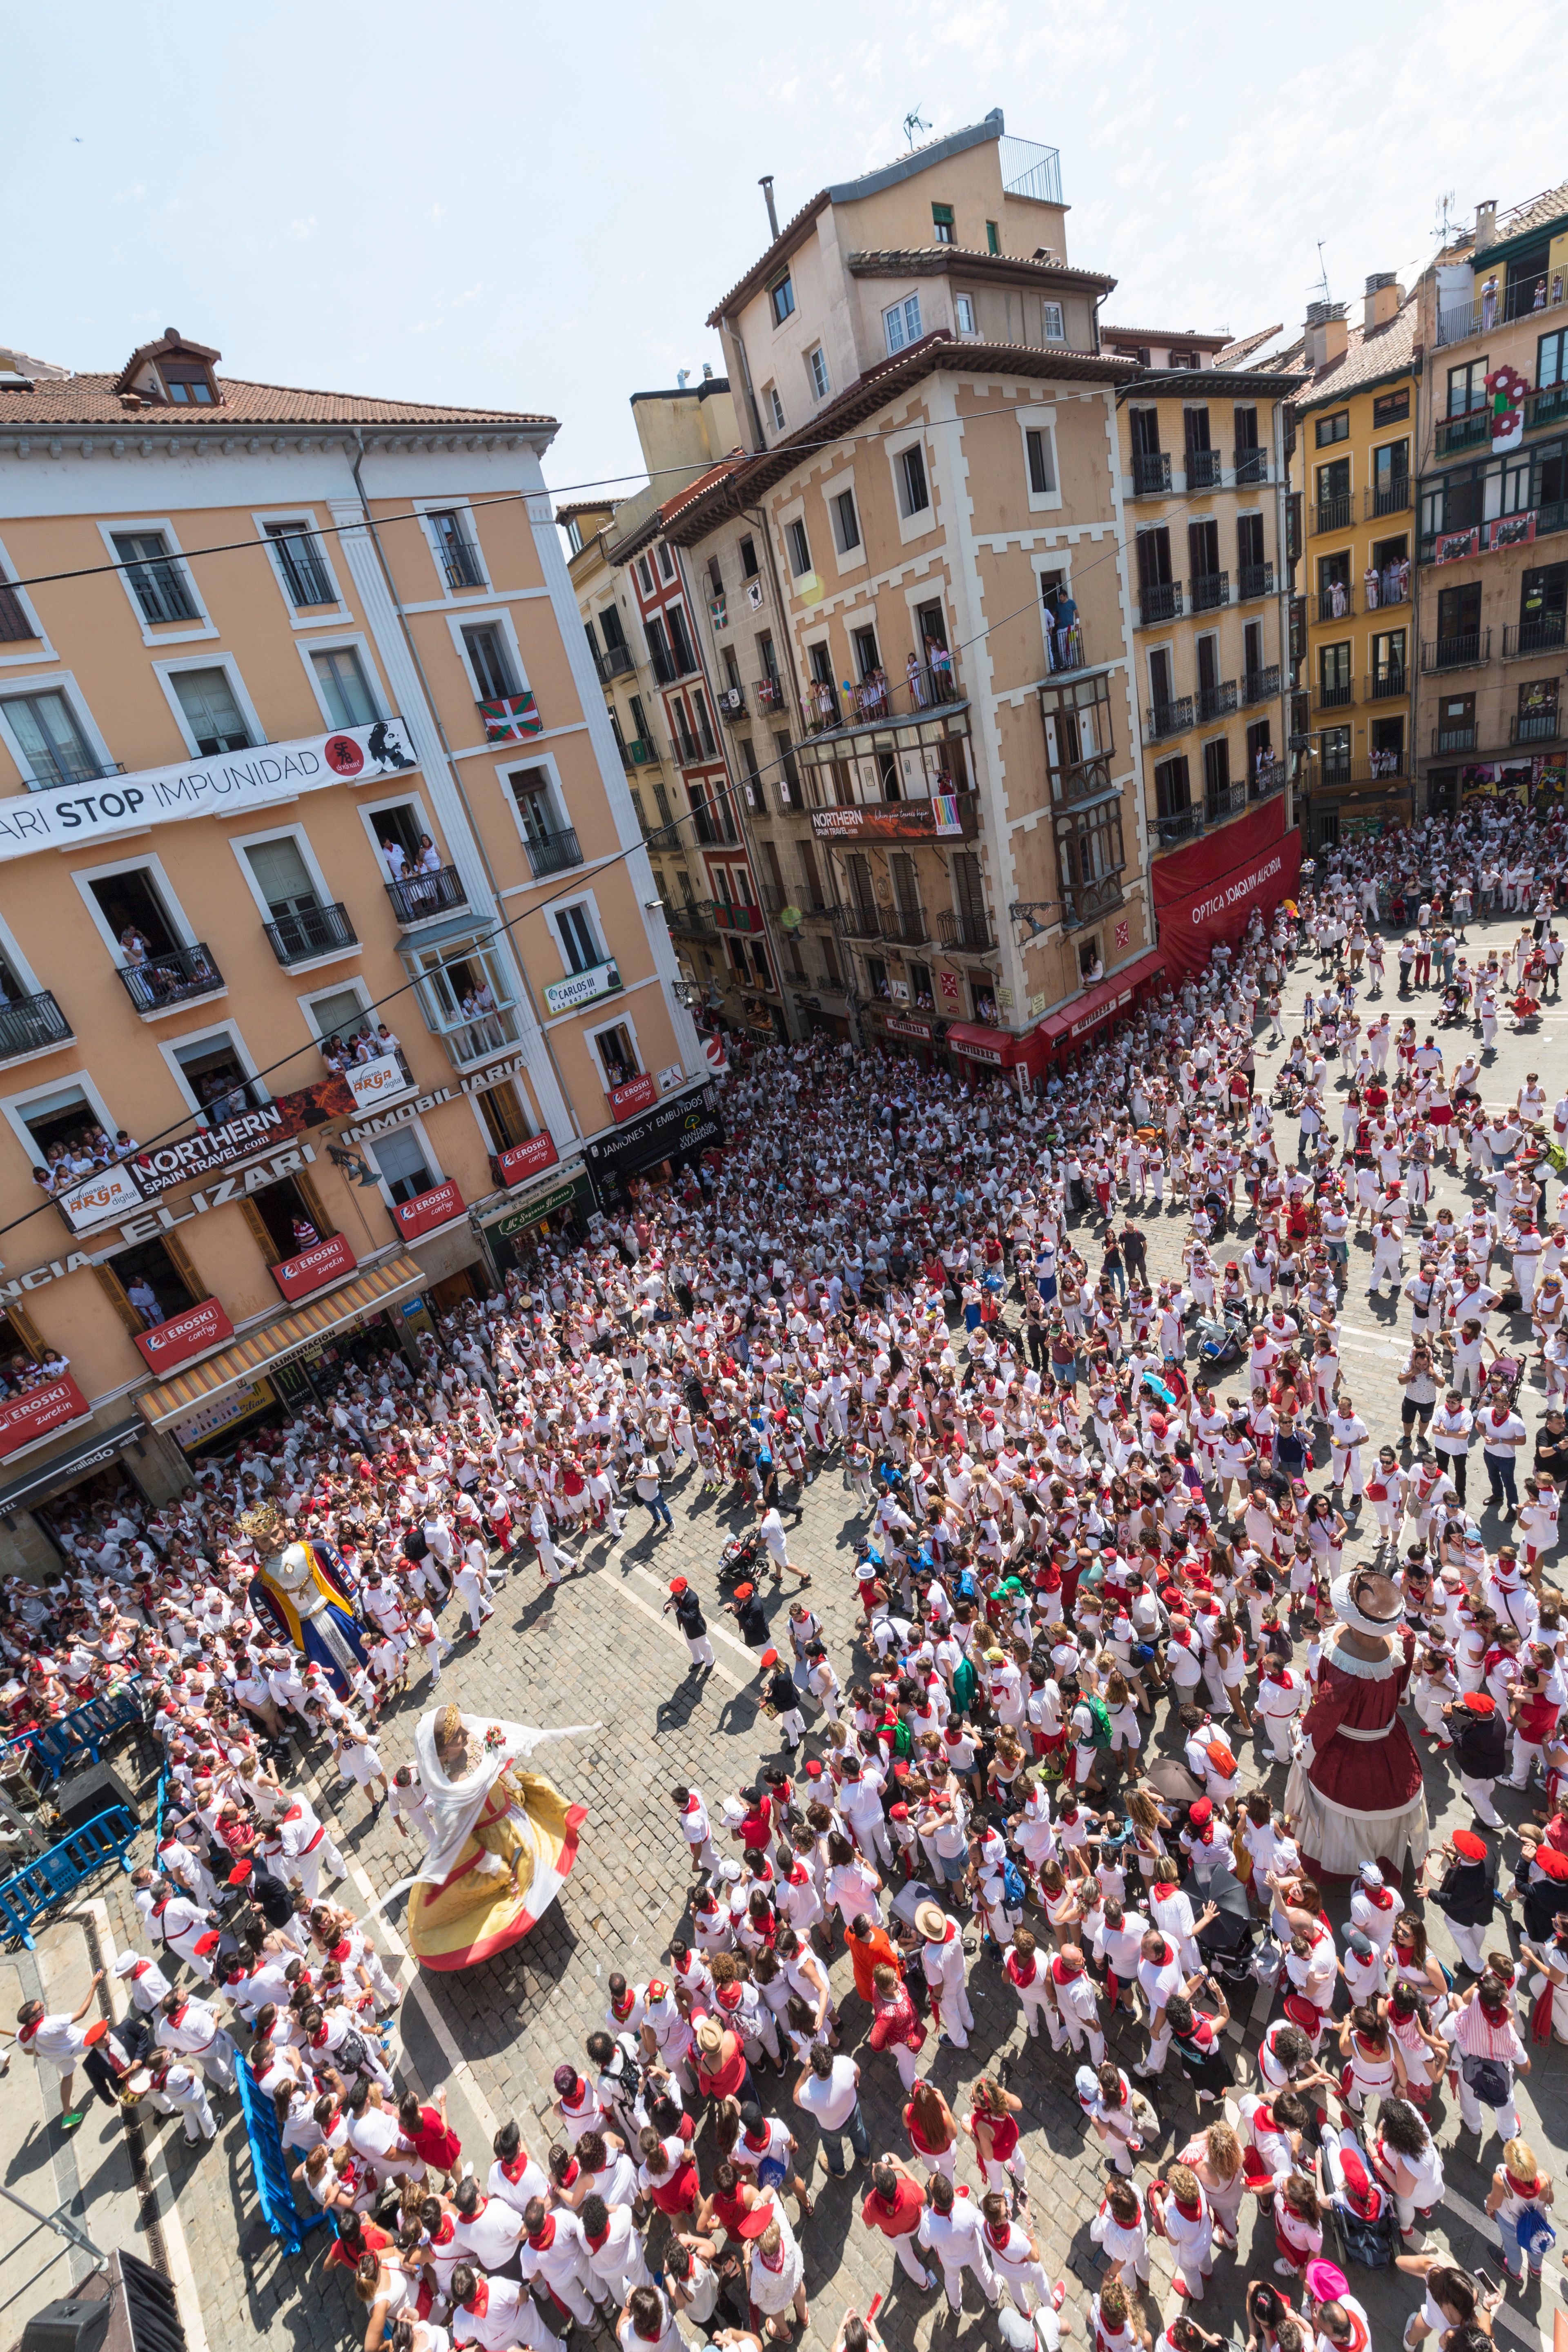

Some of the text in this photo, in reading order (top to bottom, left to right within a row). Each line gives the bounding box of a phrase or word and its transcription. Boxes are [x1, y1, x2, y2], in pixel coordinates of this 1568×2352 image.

[56, 788, 144, 827] STOP
[151, 751, 320, 807] IMPUNIDAD
[812, 810, 864, 828] NORTHERN
[1192, 895, 1224, 924] OPTICA
[1225, 873, 1256, 905] JOAQUIN
[556, 972, 592, 990] INMOBILIARIA
[558, 981, 586, 1000] CARLOS
[552, 989, 597, 1011] 649 847 747
[1077, 1002, 1111, 1030] GUTIERREZ
[892, 1020, 924, 1035] GUTIERREZ
[957, 1042, 995, 1060] GUTIERREZ
[352, 1070, 380, 1085] Luminosos
[354, 1069, 392, 1093] ARGA
[384, 1076, 402, 1089] digital
[624, 1080, 650, 1097] EROSKI
[635, 1089, 651, 1102] contigo
[646, 1122, 653, 1131] Y
[131, 1106, 282, 1183] NORTHERN
[680, 1125, 717, 1150] SALAMANCA
[120, 1143, 317, 1245] ELIZARI
[340, 1055, 529, 1146] INMOBILIARIA
[516, 1139, 546, 1159] EROSKI
[528, 1151, 548, 1163] contigo
[143, 1134, 270, 1194] SPAIN TRAVEL.com
[67, 1184, 105, 1204] Luminosos
[70, 1183, 122, 1214] ARGA
[112, 1189, 137, 1207] digital
[416, 1189, 451, 1212] EROSKI
[519, 1193, 539, 1206] Sagrario
[540, 1182, 559, 1195] Navarro
[431, 1200, 454, 1216] contigo
[519, 1205, 545, 1223] Sagrario
[546, 1190, 569, 1207] Navarro
[300, 1244, 339, 1269] EROSKI
[317, 1256, 344, 1275] zurekin
[444, 1261, 451, 1270] 2
[167, 1310, 214, 1339] EROSKI
[188, 1323, 217, 1342] contigo
[269, 1330, 336, 1372] ALIMENTACIÓN
[304, 1347, 321, 1358] hielo
[11, 1387, 65, 1420] EROSKI
[35, 1401, 73, 1425] zurekin
